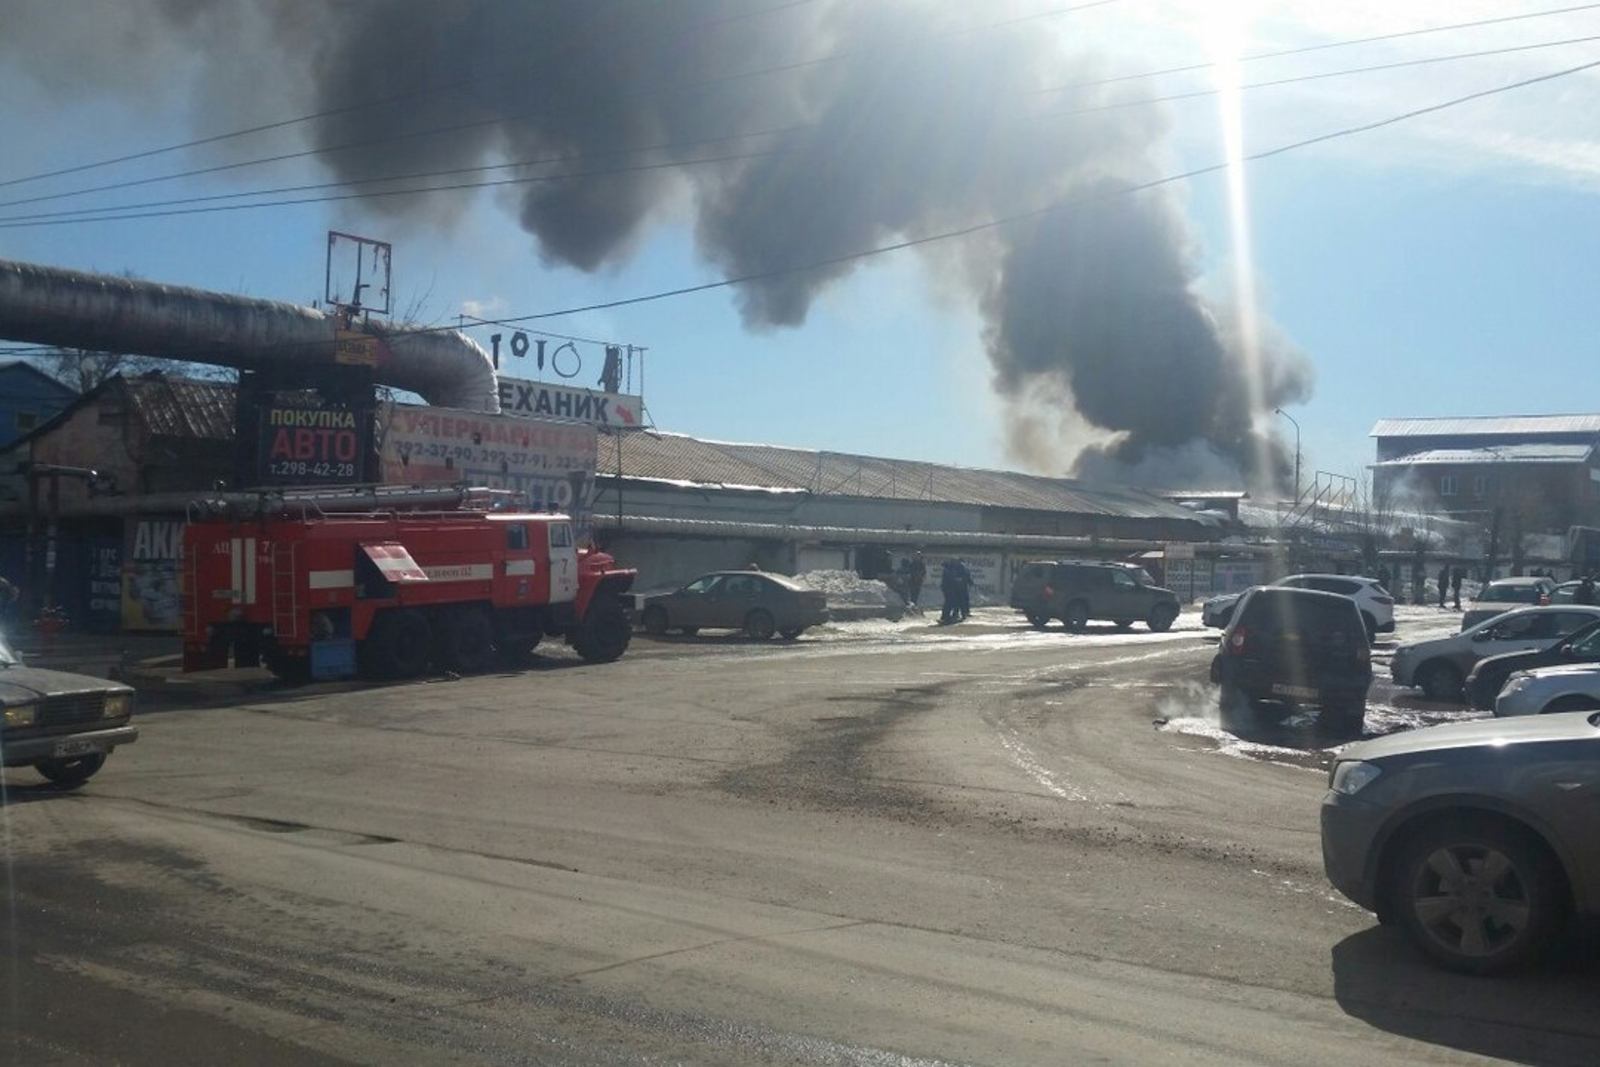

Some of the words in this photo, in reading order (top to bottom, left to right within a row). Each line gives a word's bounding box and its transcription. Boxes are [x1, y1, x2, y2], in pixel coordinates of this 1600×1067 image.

[269, 408, 356, 428] ПОКУПКА
[269, 427, 358, 463] АВТО
[269, 461, 355, 477] т.298-42-28
[262, 540, 271, 554] 7
[561, 558, 569, 575] 7
